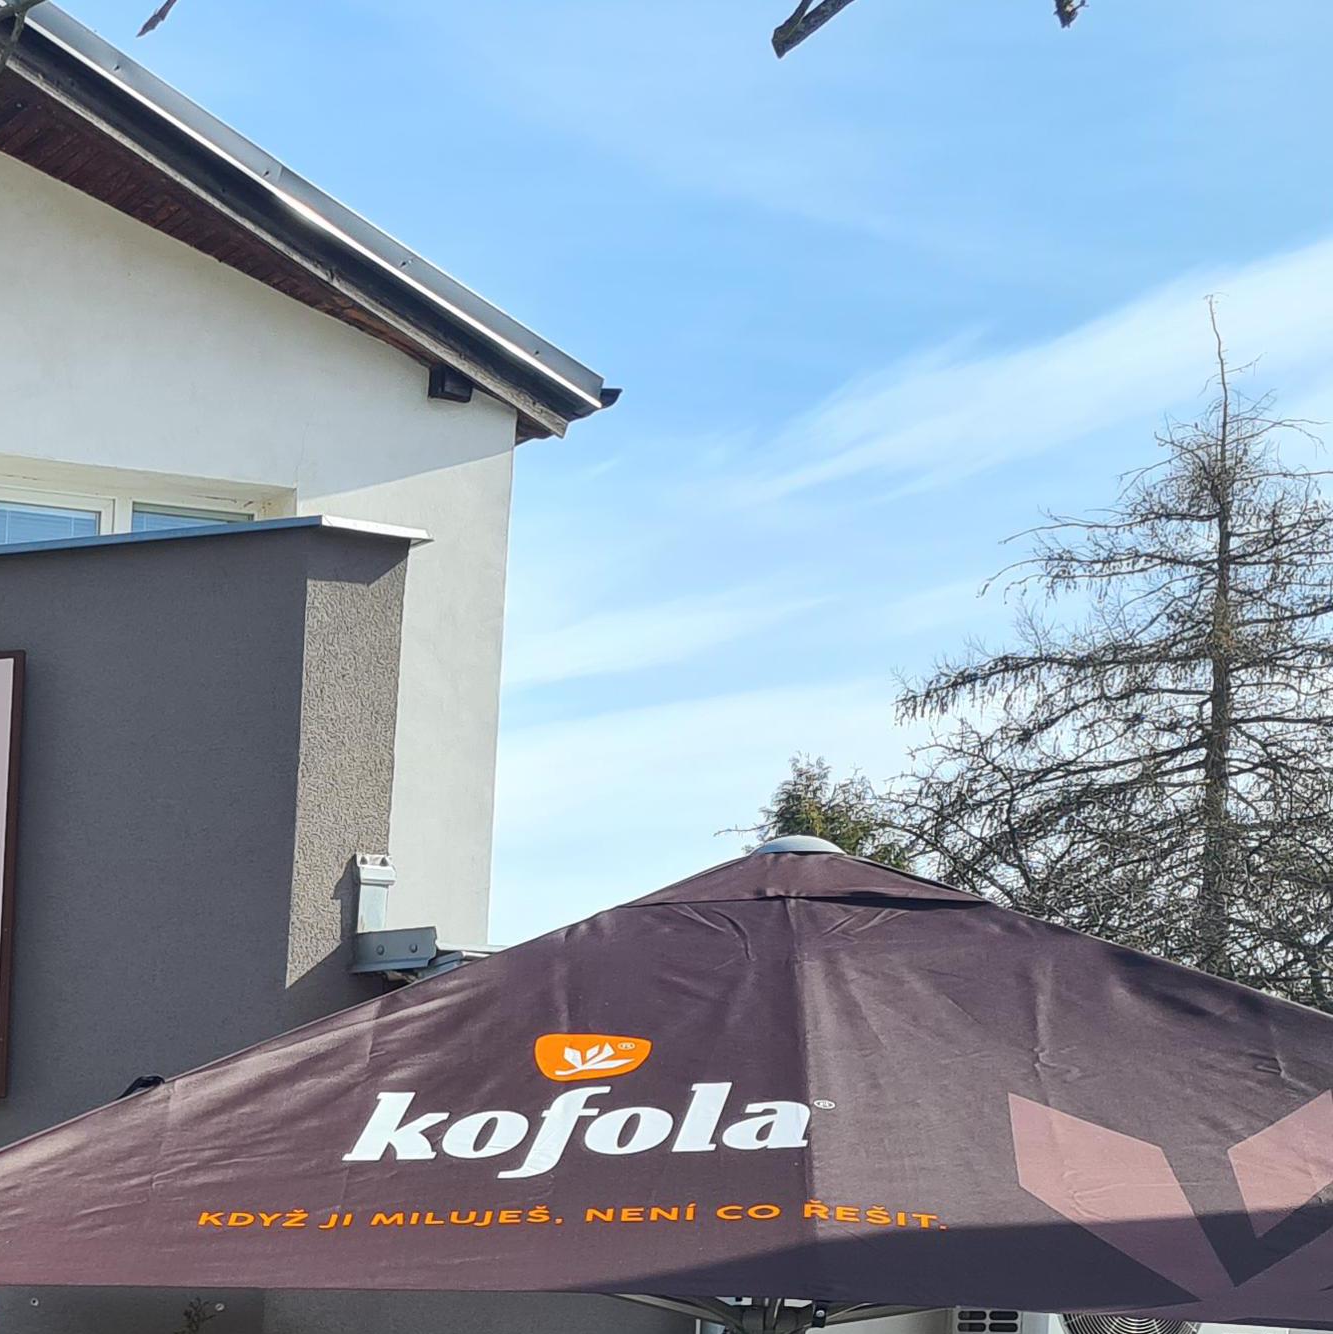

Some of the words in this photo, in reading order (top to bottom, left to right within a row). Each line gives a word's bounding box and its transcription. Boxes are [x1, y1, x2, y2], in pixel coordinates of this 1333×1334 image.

[342, 1081, 810, 1179] kofola
[198, 1208, 309, 1227] KDYŽ
[319, 1213, 353, 1229] JI
[370, 1206, 565, 1228] MILUJEŠ,
[585, 1203, 697, 1222] NENÍ
[716, 1204, 781, 1221] CO
[803, 1200, 949, 1231] ŘEŠIT.
